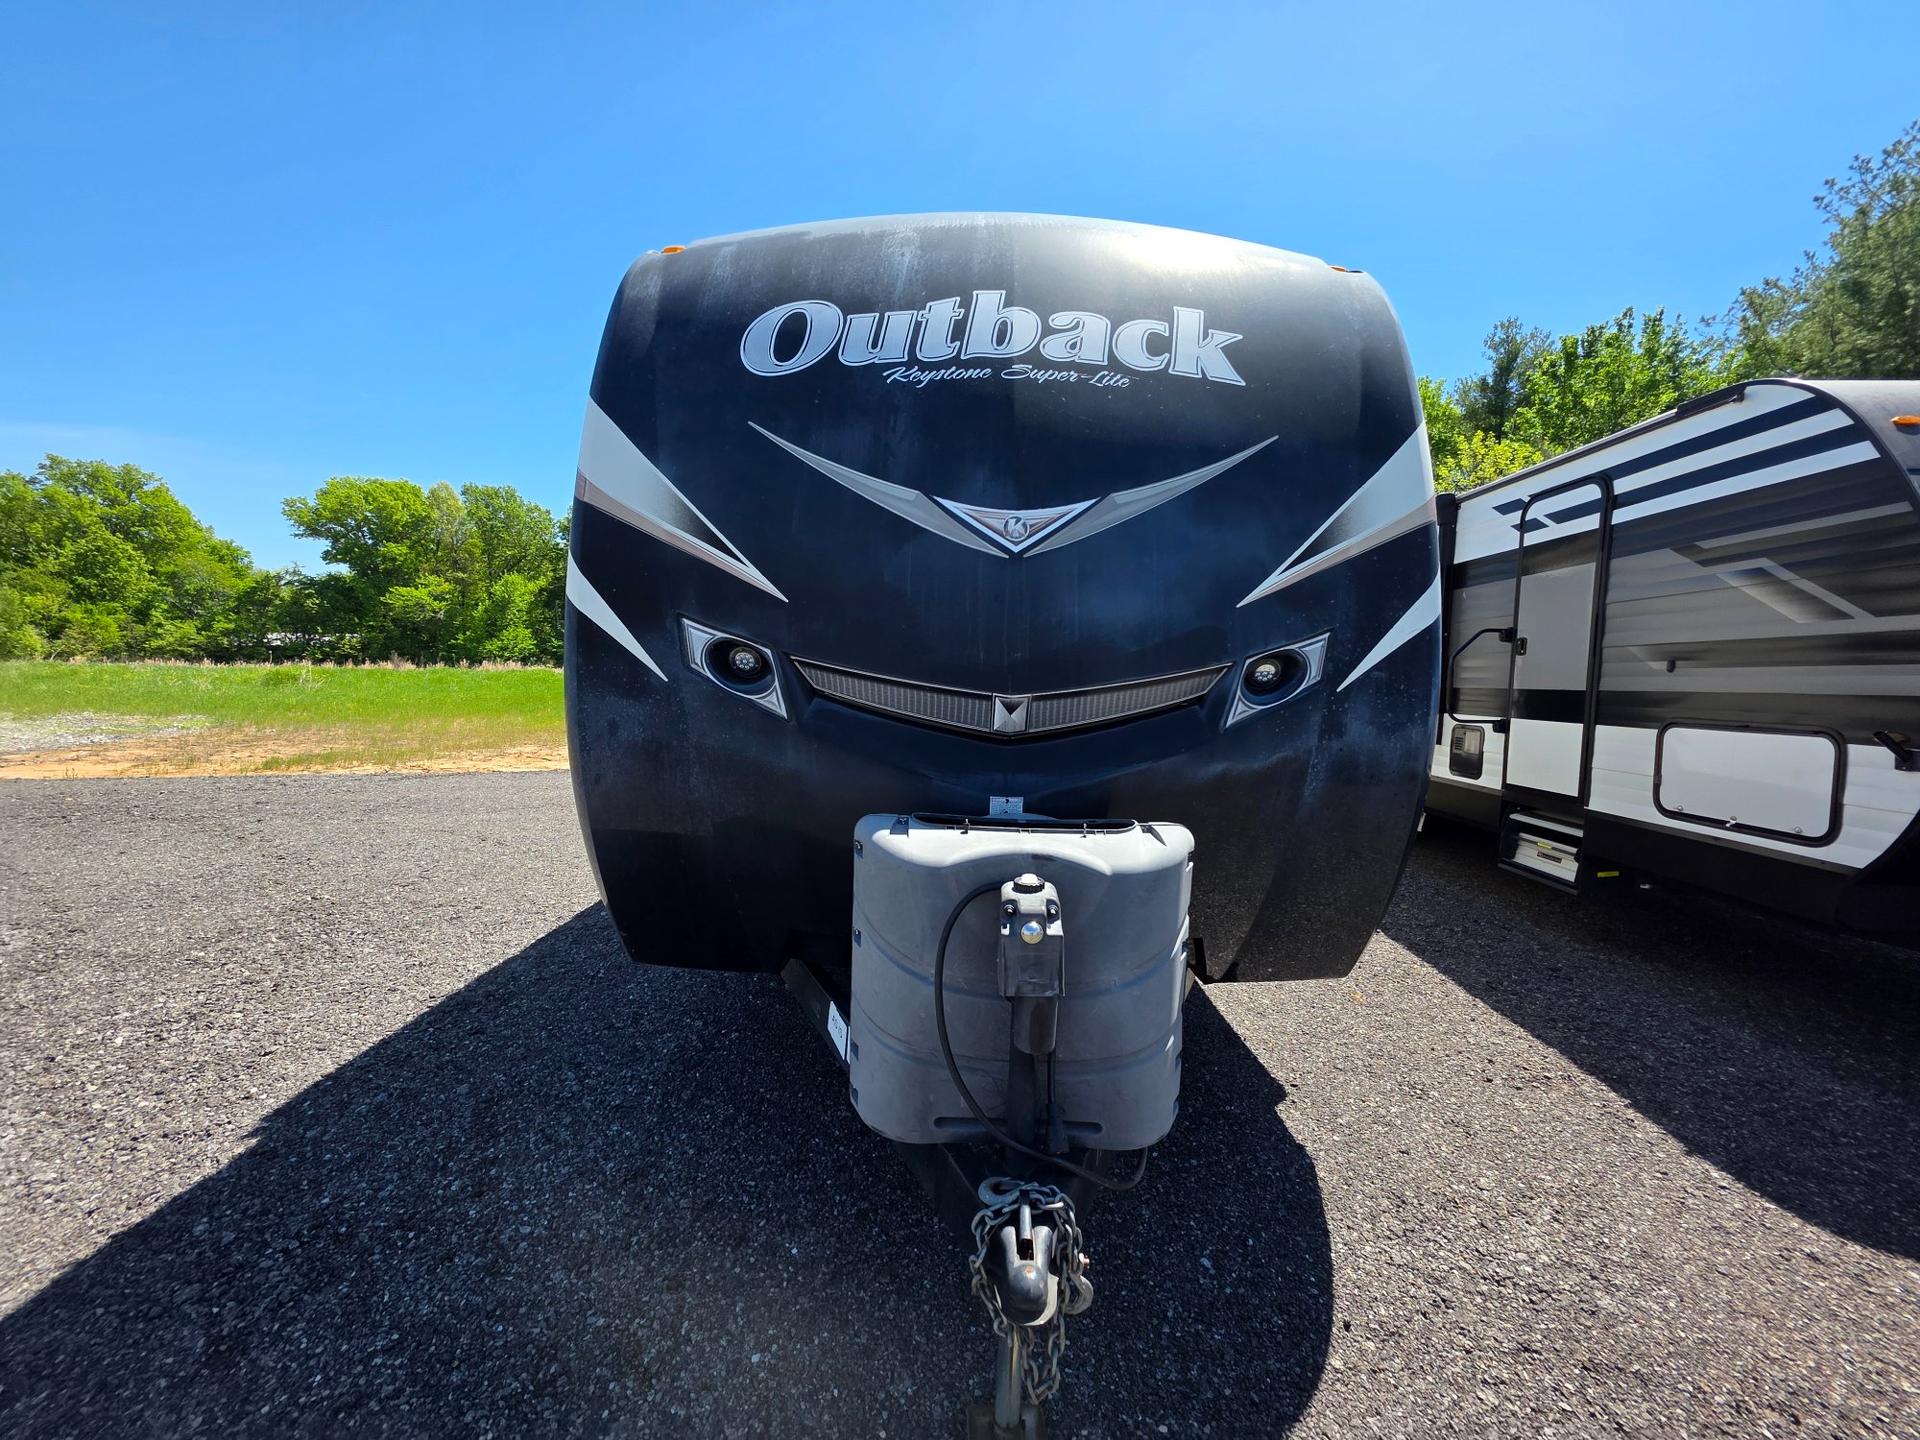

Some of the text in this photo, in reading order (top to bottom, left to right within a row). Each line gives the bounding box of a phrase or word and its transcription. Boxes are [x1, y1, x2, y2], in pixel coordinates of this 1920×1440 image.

[740, 290, 1246, 385] Outback
[882, 364, 1131, 388] Keystone Super-Lite
